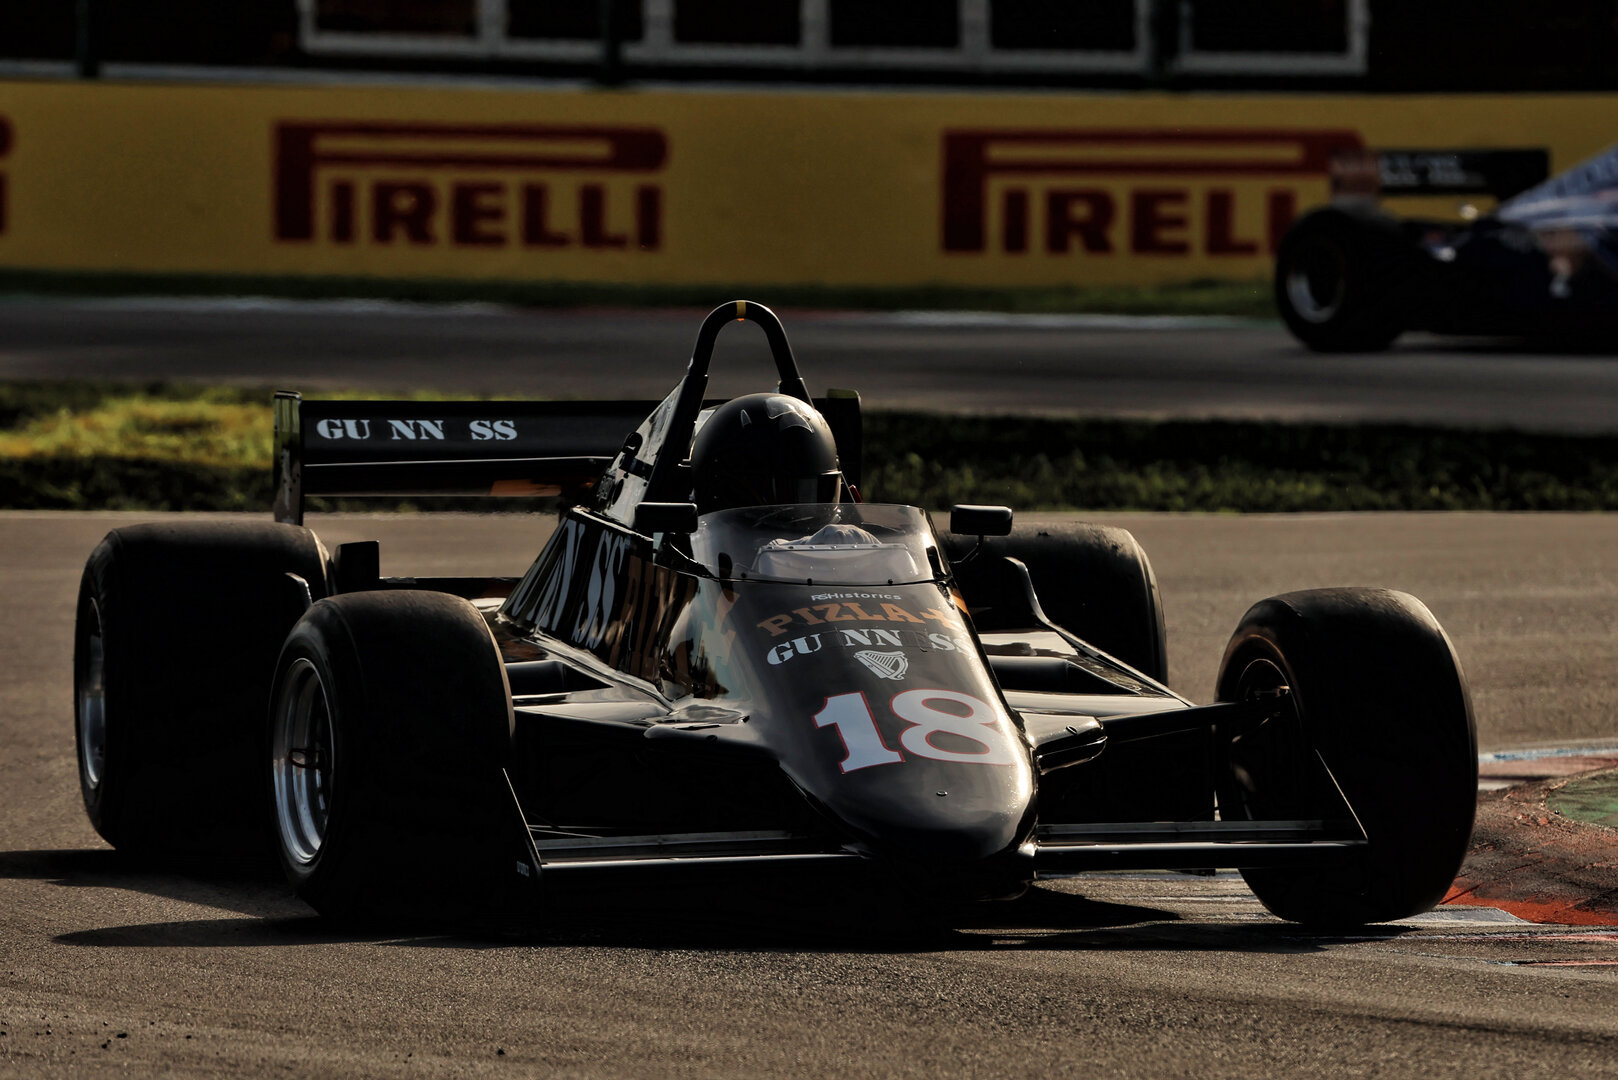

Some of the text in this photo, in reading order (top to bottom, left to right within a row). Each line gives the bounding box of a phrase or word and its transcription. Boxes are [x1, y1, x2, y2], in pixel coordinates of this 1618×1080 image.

[273, 121, 667, 251] PIRELLI
[316, 418, 518, 441] GU NN SS
[766, 632, 824, 665] GU
[839, 628, 904, 648] NN
[811, 688, 1015, 774] 18
